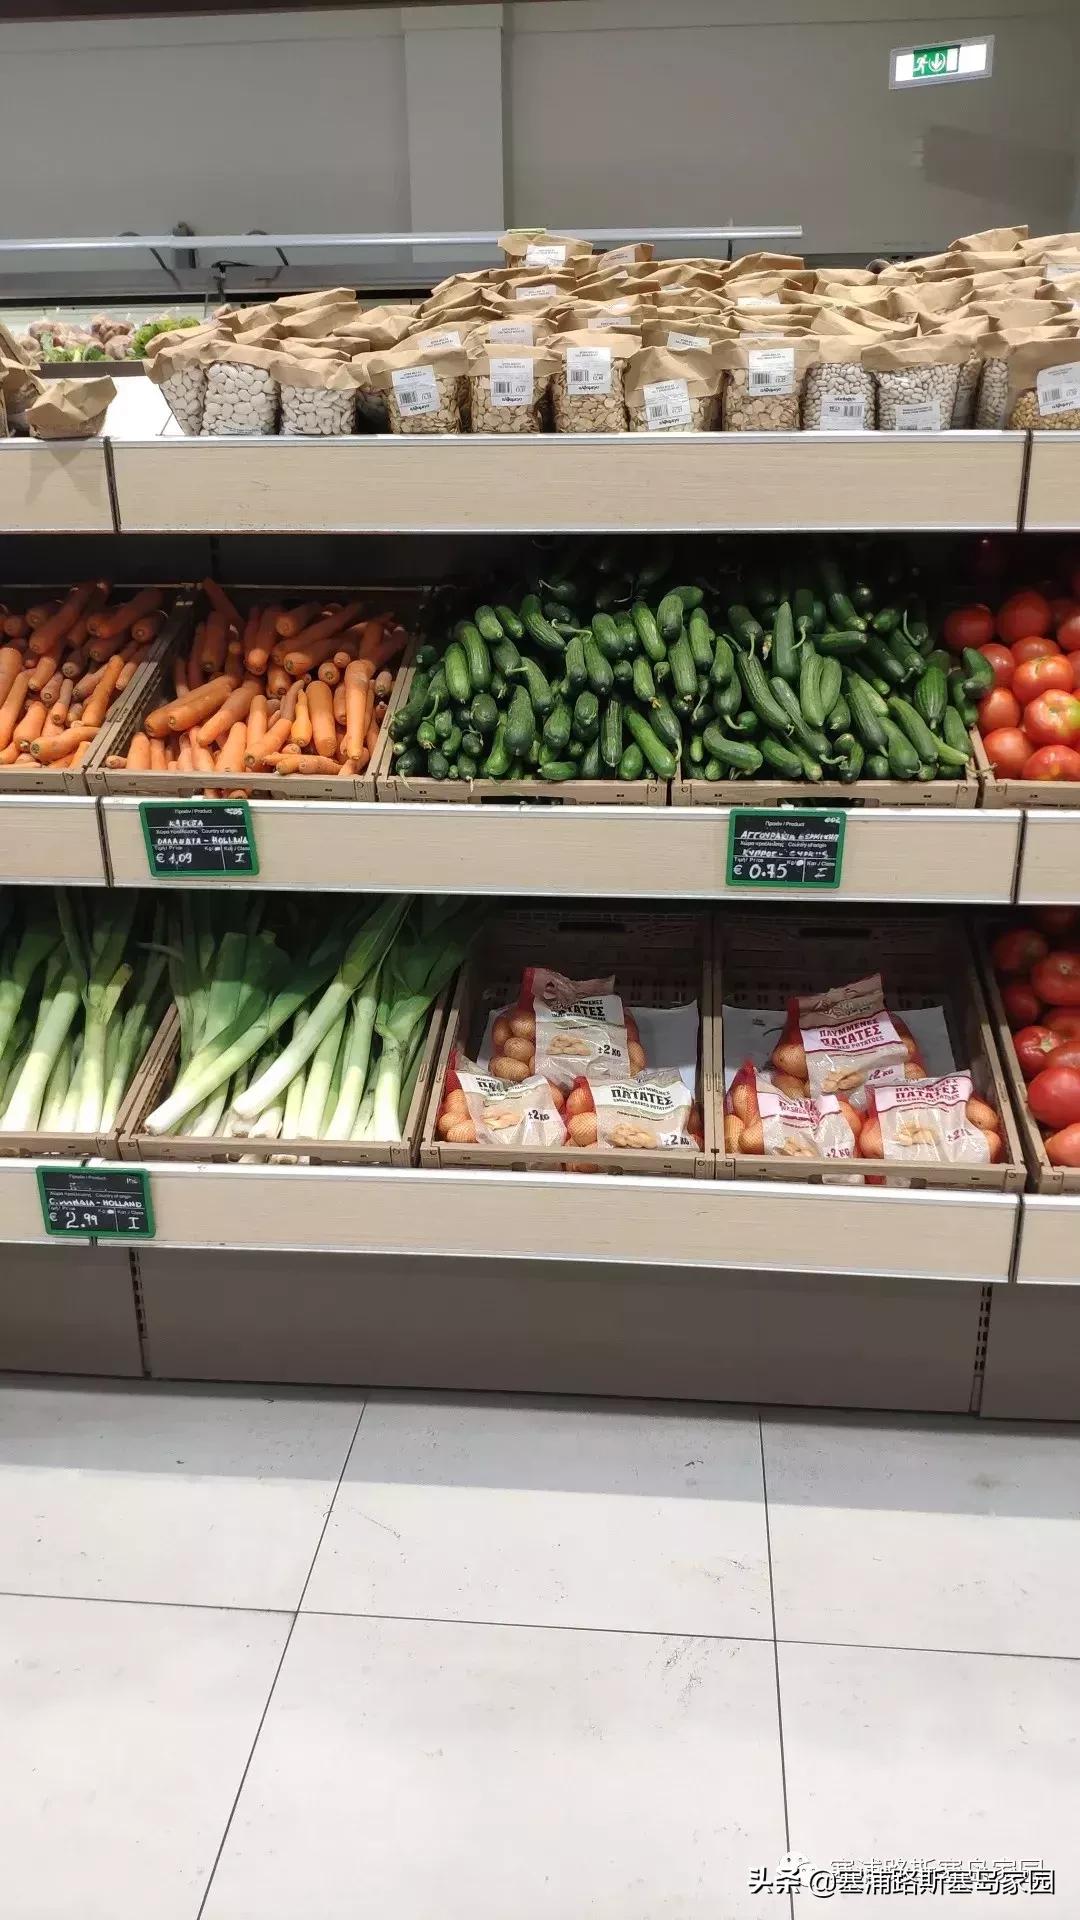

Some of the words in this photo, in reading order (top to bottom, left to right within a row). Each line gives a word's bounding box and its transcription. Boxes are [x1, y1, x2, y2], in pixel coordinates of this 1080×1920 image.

[156, 853, 165, 863] €
[733, 864, 743, 875] €
[749, 863, 788, 879] 0.75
[820, 1018, 880, 1038] ΠΛΥΜΜΕΝΕΣ
[820, 1025, 882, 1046] ΠΑΤΑΤΕΣ
[611, 1089, 673, 1106] ΠΑΤΑΤΕΣ
[102, 1199, 142, 1208] HOLLAND
[50, 1212, 58, 1222] €
[66, 1211, 98, 1228] 2.99
